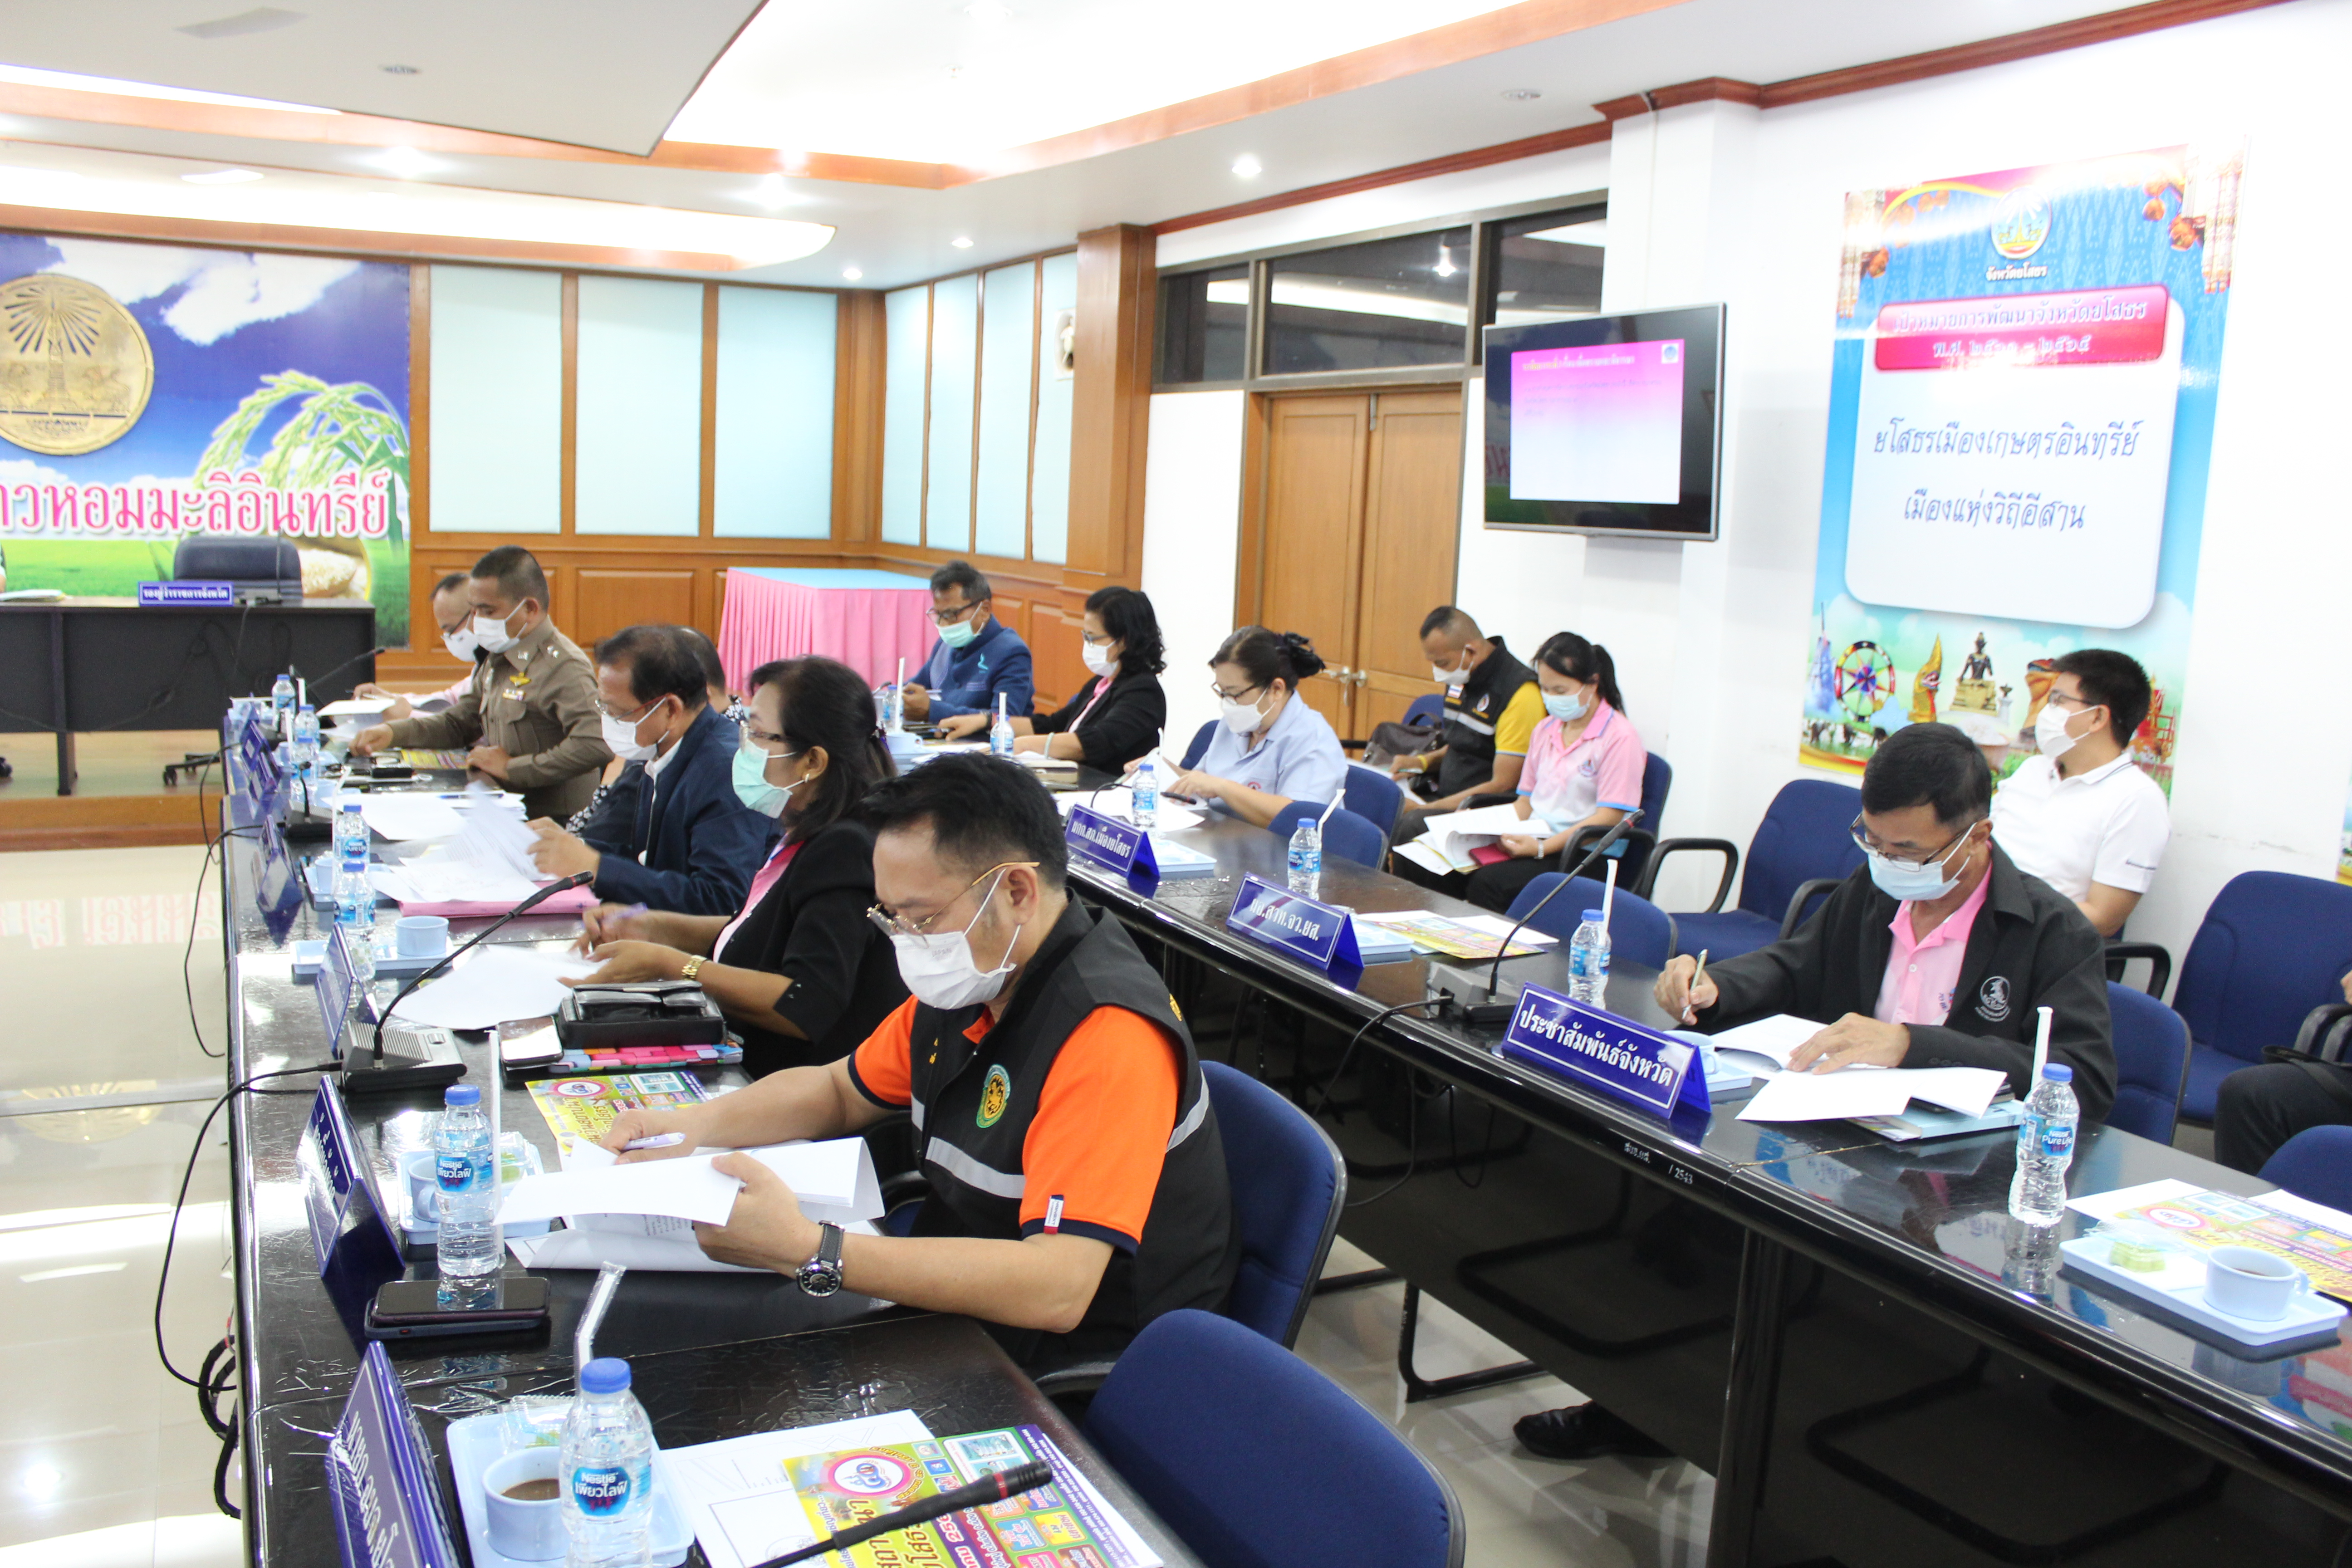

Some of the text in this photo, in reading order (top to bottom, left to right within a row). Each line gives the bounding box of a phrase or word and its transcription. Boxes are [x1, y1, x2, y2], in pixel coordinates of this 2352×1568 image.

[1986, 263, 2048, 281] จังหวัดยโสธร
[1893, 295, 2147, 333] เป้าหมายการพัฒนาจังหวัดยโสธร
[1874, 417, 2144, 460] ยโสธรเมืองเกษตรอินทรีย์
[1903, 487, 2087, 532] เมืองแห่งวิถีอีสาน
[1519, 1004, 1674, 1088] ประชาสัมพันธ์จังหวัด
